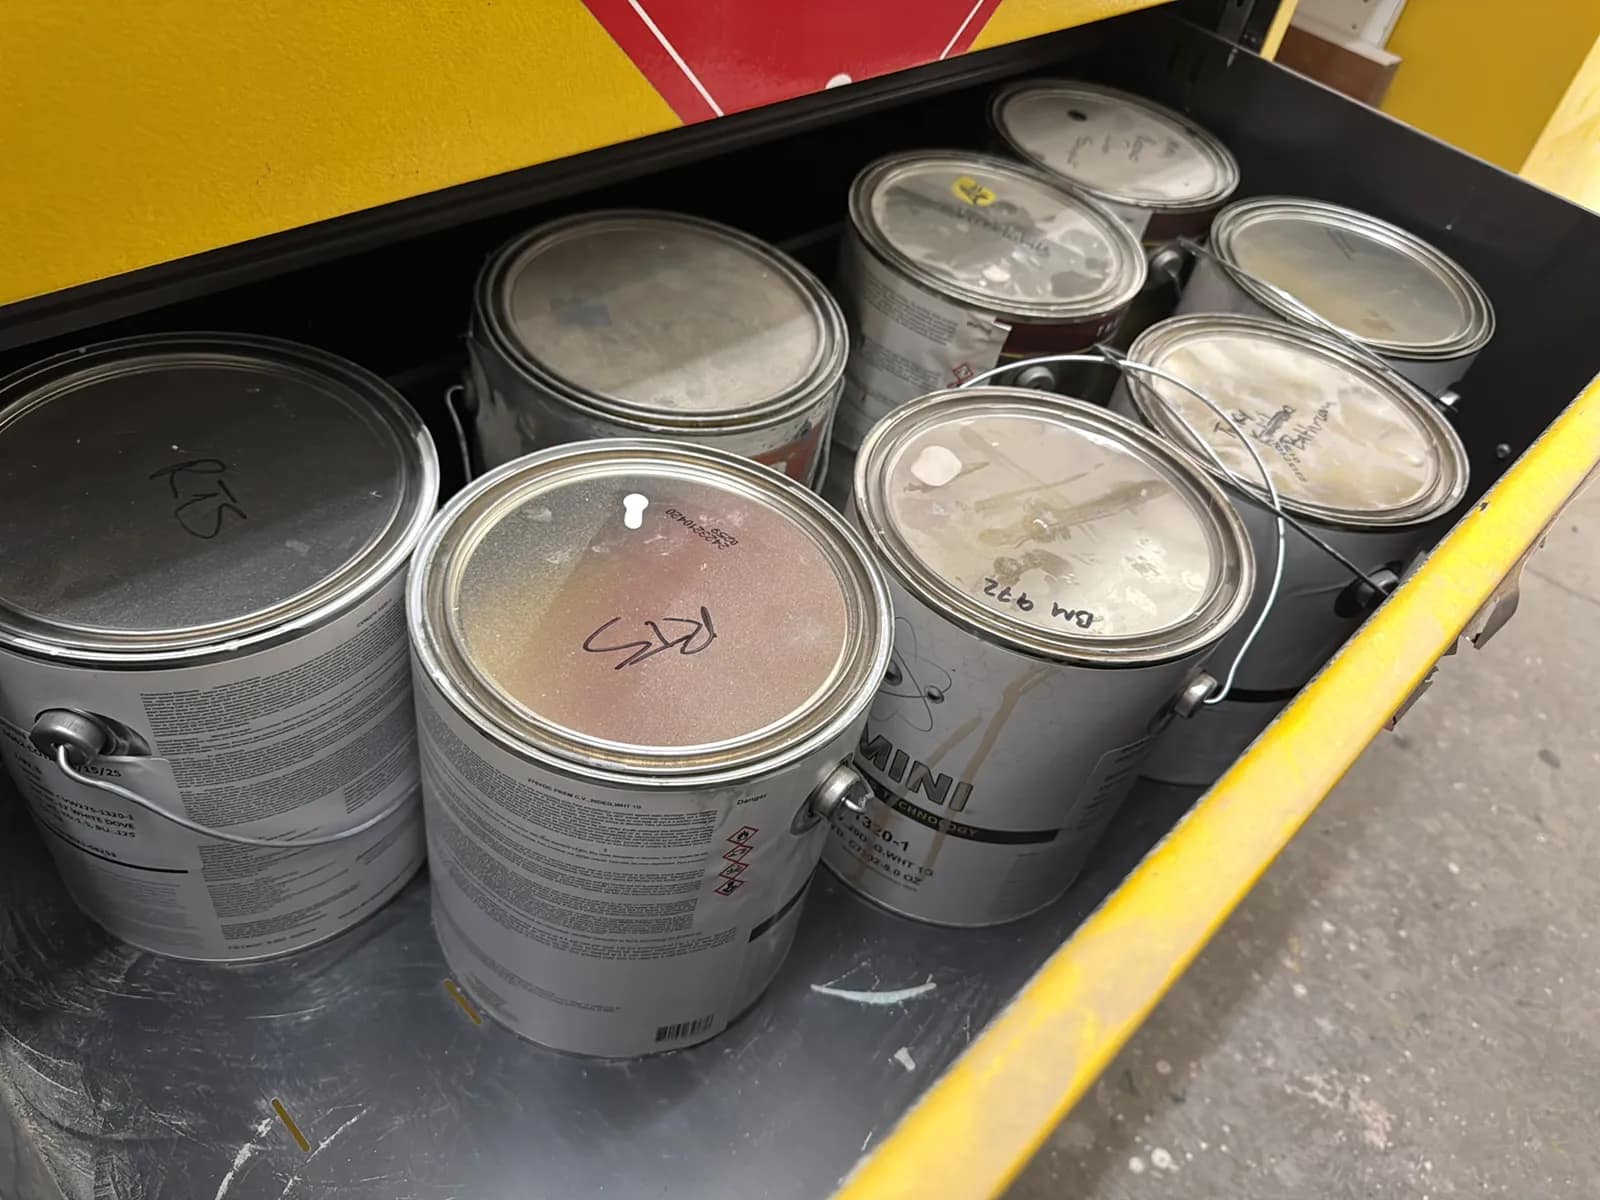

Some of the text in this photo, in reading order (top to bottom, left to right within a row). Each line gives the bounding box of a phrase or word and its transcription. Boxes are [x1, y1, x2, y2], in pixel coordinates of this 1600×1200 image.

[149, 458, 247, 540] RTS
[984, 577, 1095, 630] BM 972
[582, 606, 718, 670] RTS
[860, 724, 974, 813] MINI
[105, 818, 135, 831] DOVE
[736, 793, 769, 807] Danger
